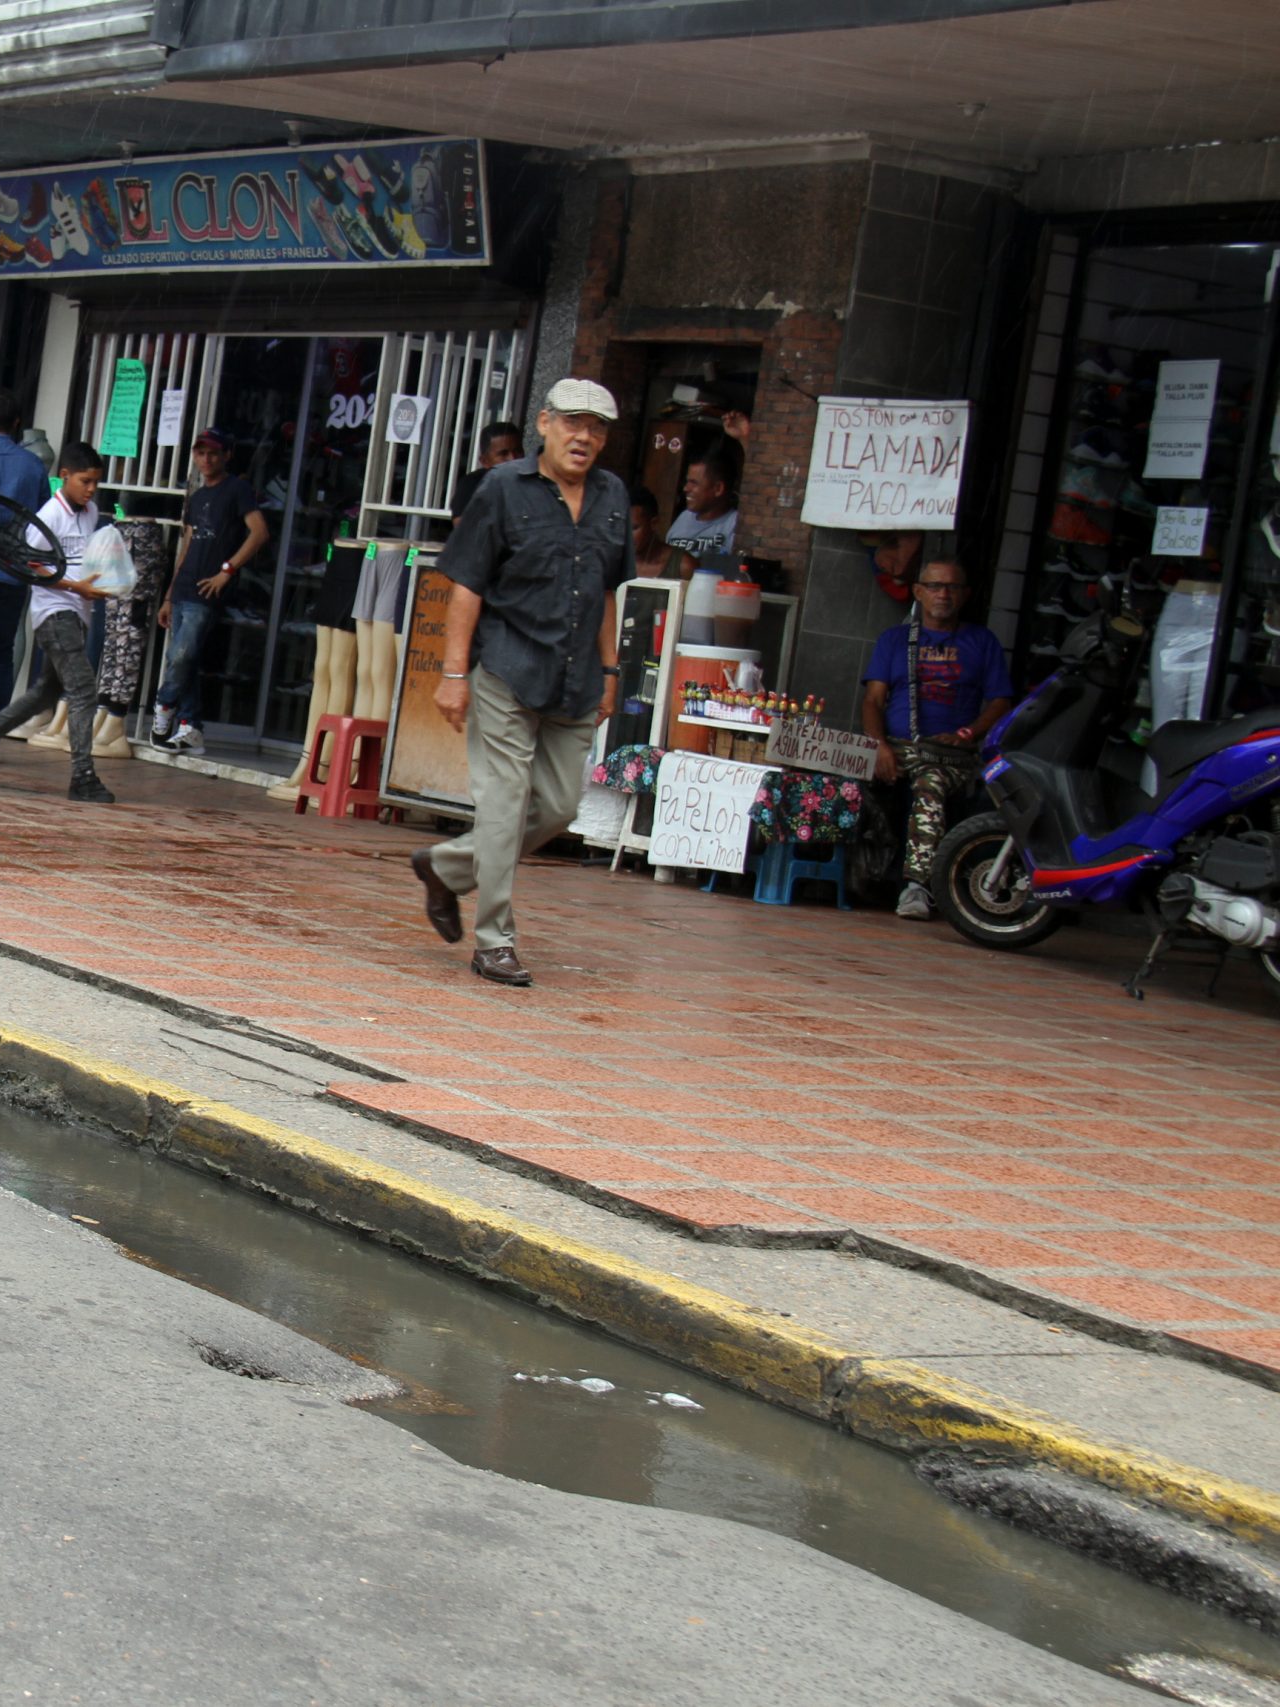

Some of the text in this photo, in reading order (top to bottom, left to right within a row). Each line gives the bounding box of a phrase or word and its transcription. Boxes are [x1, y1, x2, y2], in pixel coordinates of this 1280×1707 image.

[173, 171, 303, 244] CLON
[102, 247, 329, 265] CALZADO DEPORTIVO CHOLAS MORRALES FRANELAS
[1165, 392, 1186, 400] TALLA
[825, 408, 893, 429] TOSTON
[922, 409, 954, 426] AJO
[825, 432, 961, 479] LLAMADA
[845, 480, 907, 516] PAGO
